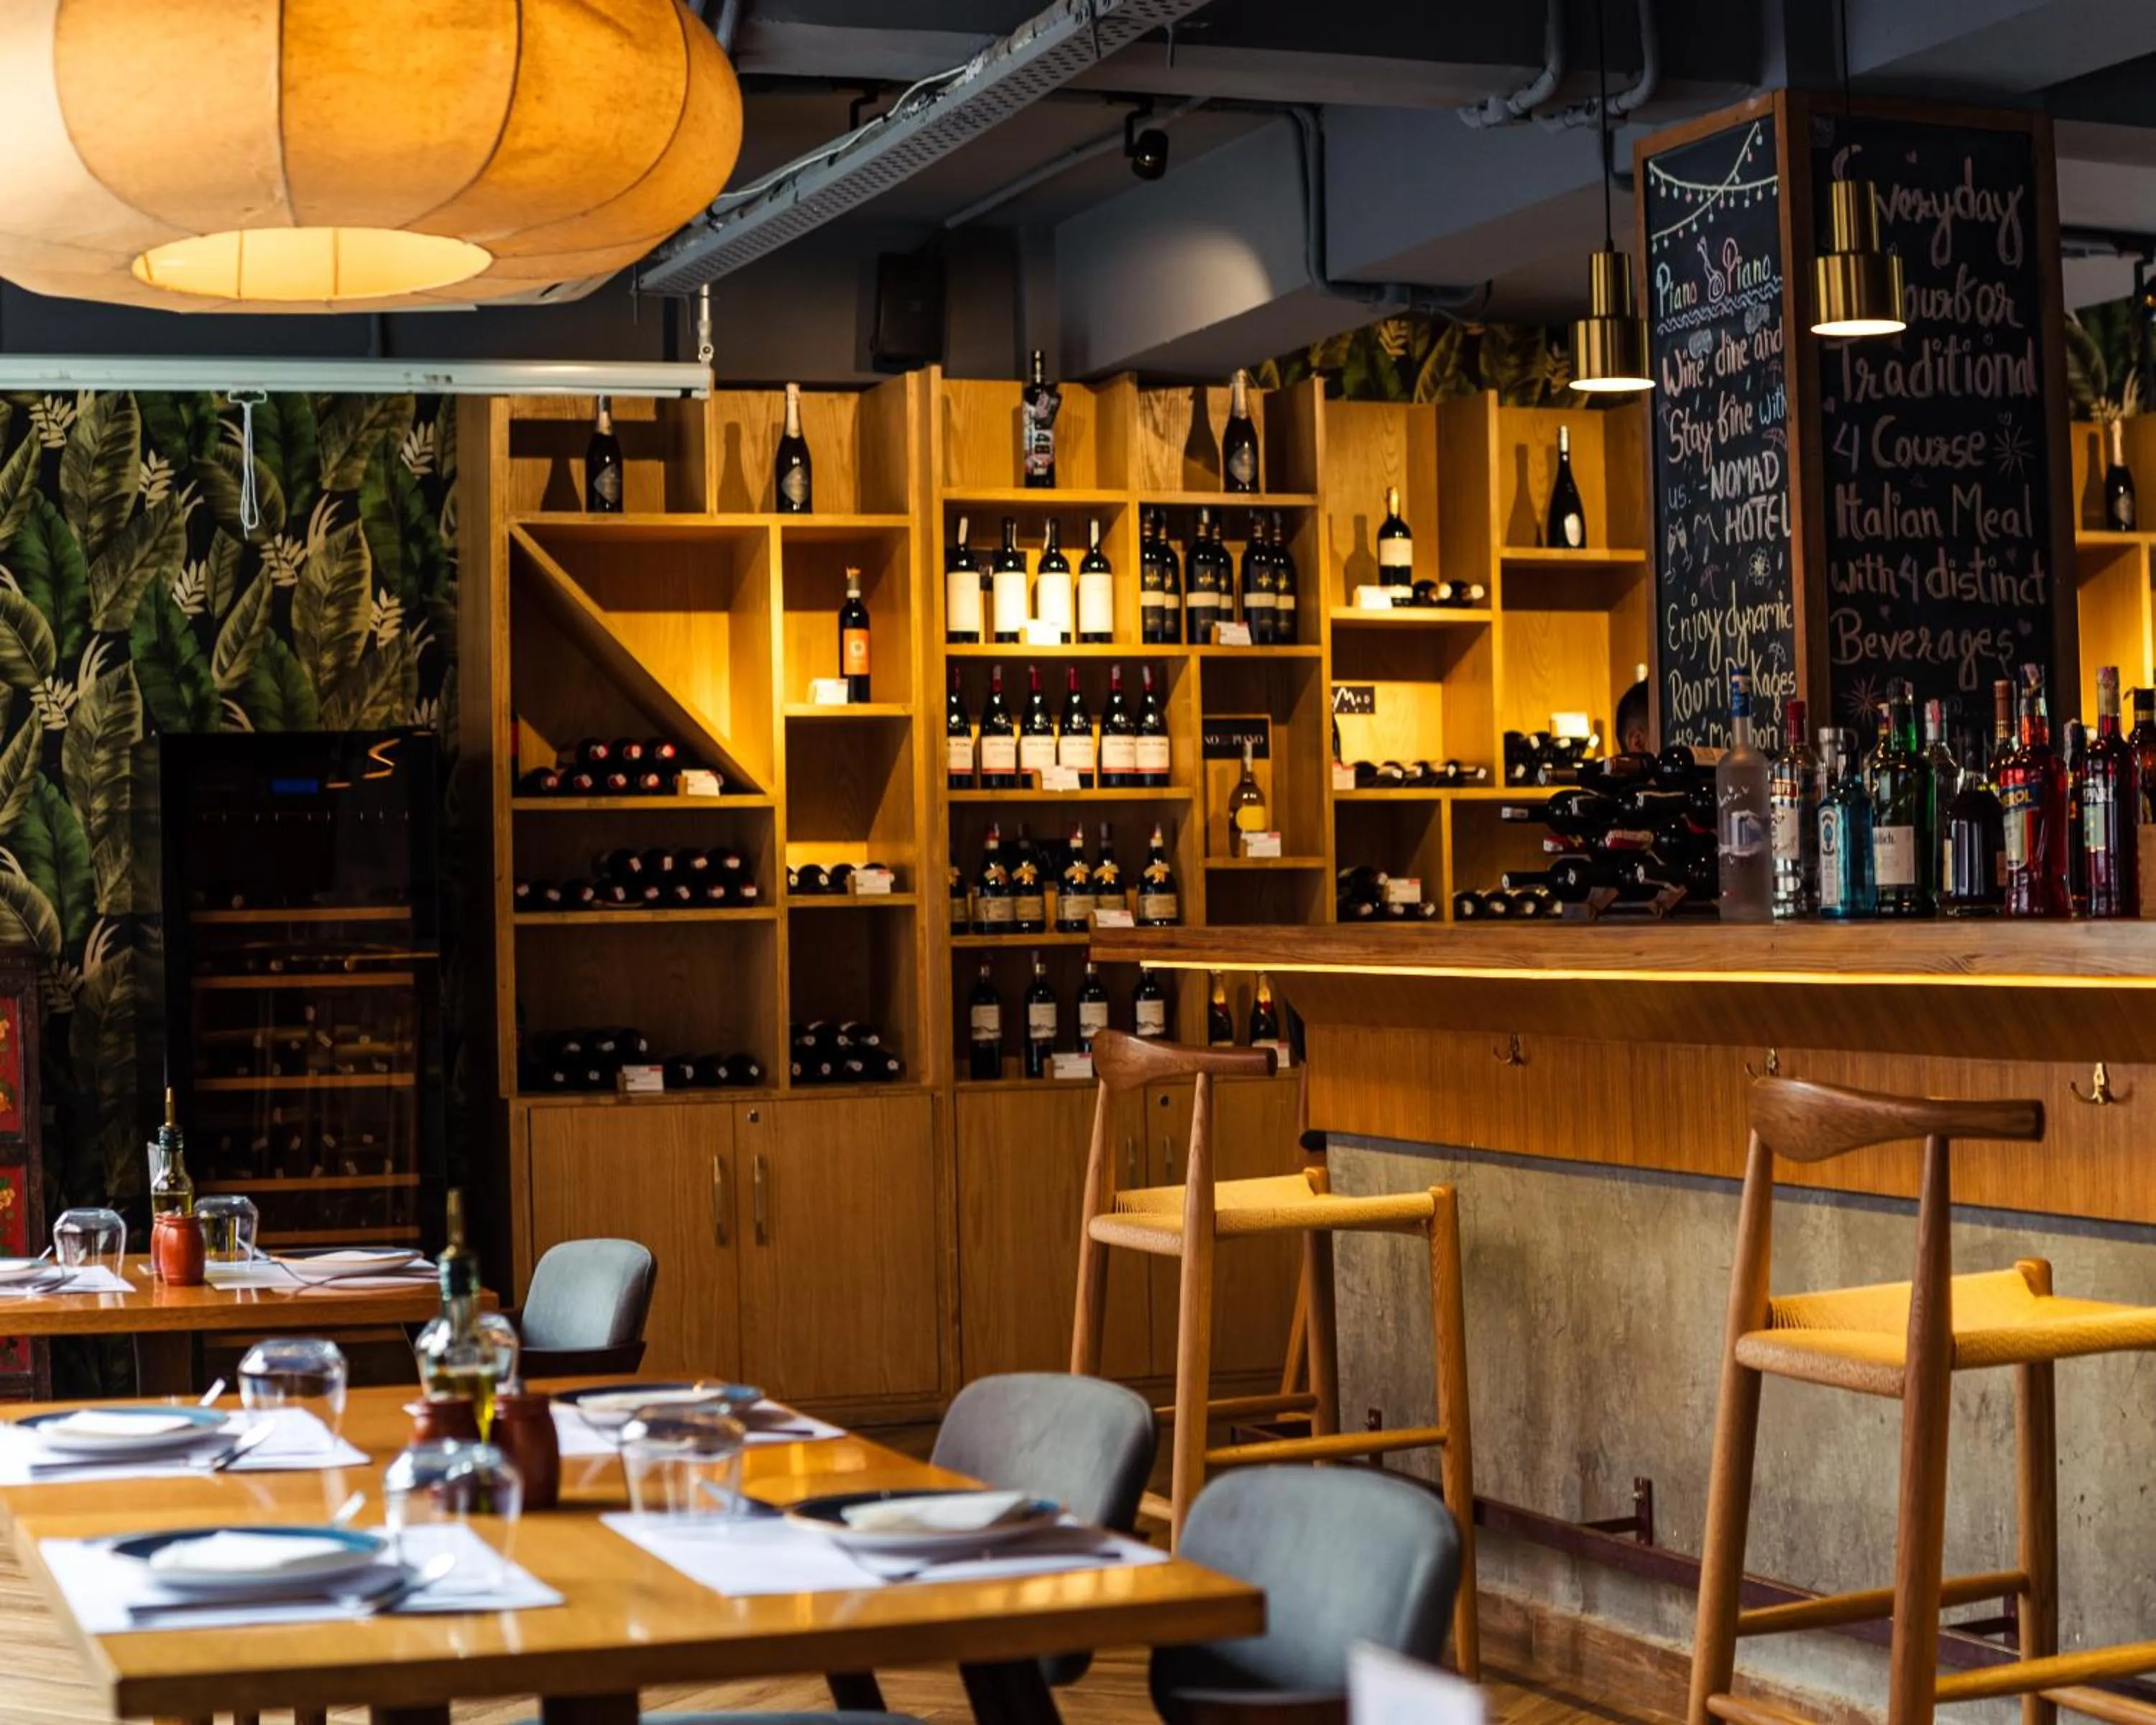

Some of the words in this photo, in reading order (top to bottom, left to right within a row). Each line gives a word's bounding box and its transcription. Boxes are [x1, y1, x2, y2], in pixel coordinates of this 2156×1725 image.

[1656, 262, 1698, 318] Piano
[1722, 236, 1772, 295] Piano
[1714, 328, 1750, 377] dine
[1754, 316, 1784, 361] and
[1667, 406, 1714, 476] Stay
[1717, 390, 1753, 445] fine
[1832, 419, 1862, 474] 4
[1871, 414, 1988, 471] Course
[1725, 491, 1792, 546] HOTEL
[1835, 480, 1943, 542] Italian
[1950, 482, 2034, 545] Meal
[1830, 552, 1901, 599] with
[1898, 551, 1920, 604] 4
[1925, 545, 2047, 607] distinct
[1667, 592, 1723, 675] Enjoy
[1725, 579, 1793, 667] dynamic
[1829, 607, 2015, 692] Beverages
